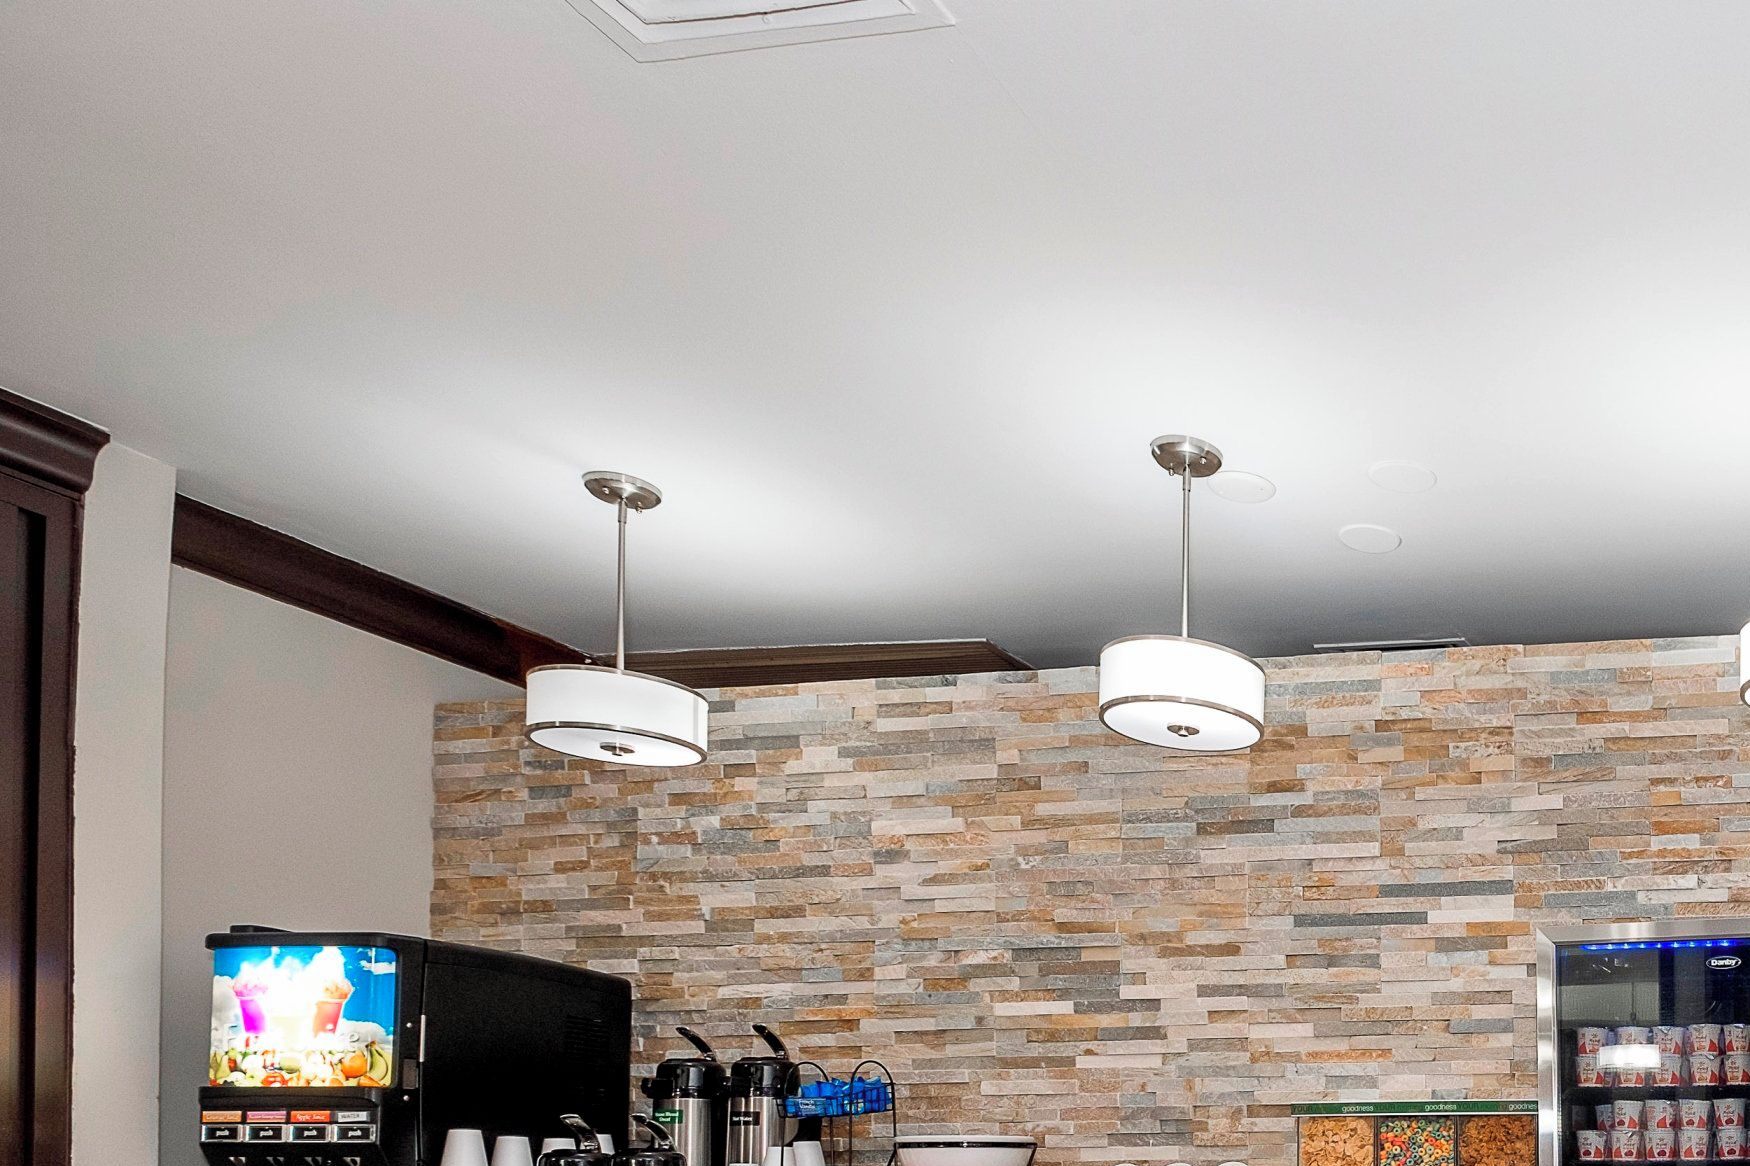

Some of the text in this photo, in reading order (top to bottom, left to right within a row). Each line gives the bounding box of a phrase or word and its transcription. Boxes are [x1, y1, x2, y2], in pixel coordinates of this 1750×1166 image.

[1711, 958, 1737, 966] Danby
[1342, 1104, 1374, 1113] goodness
[1424, 1103, 1457, 1112] goodness
